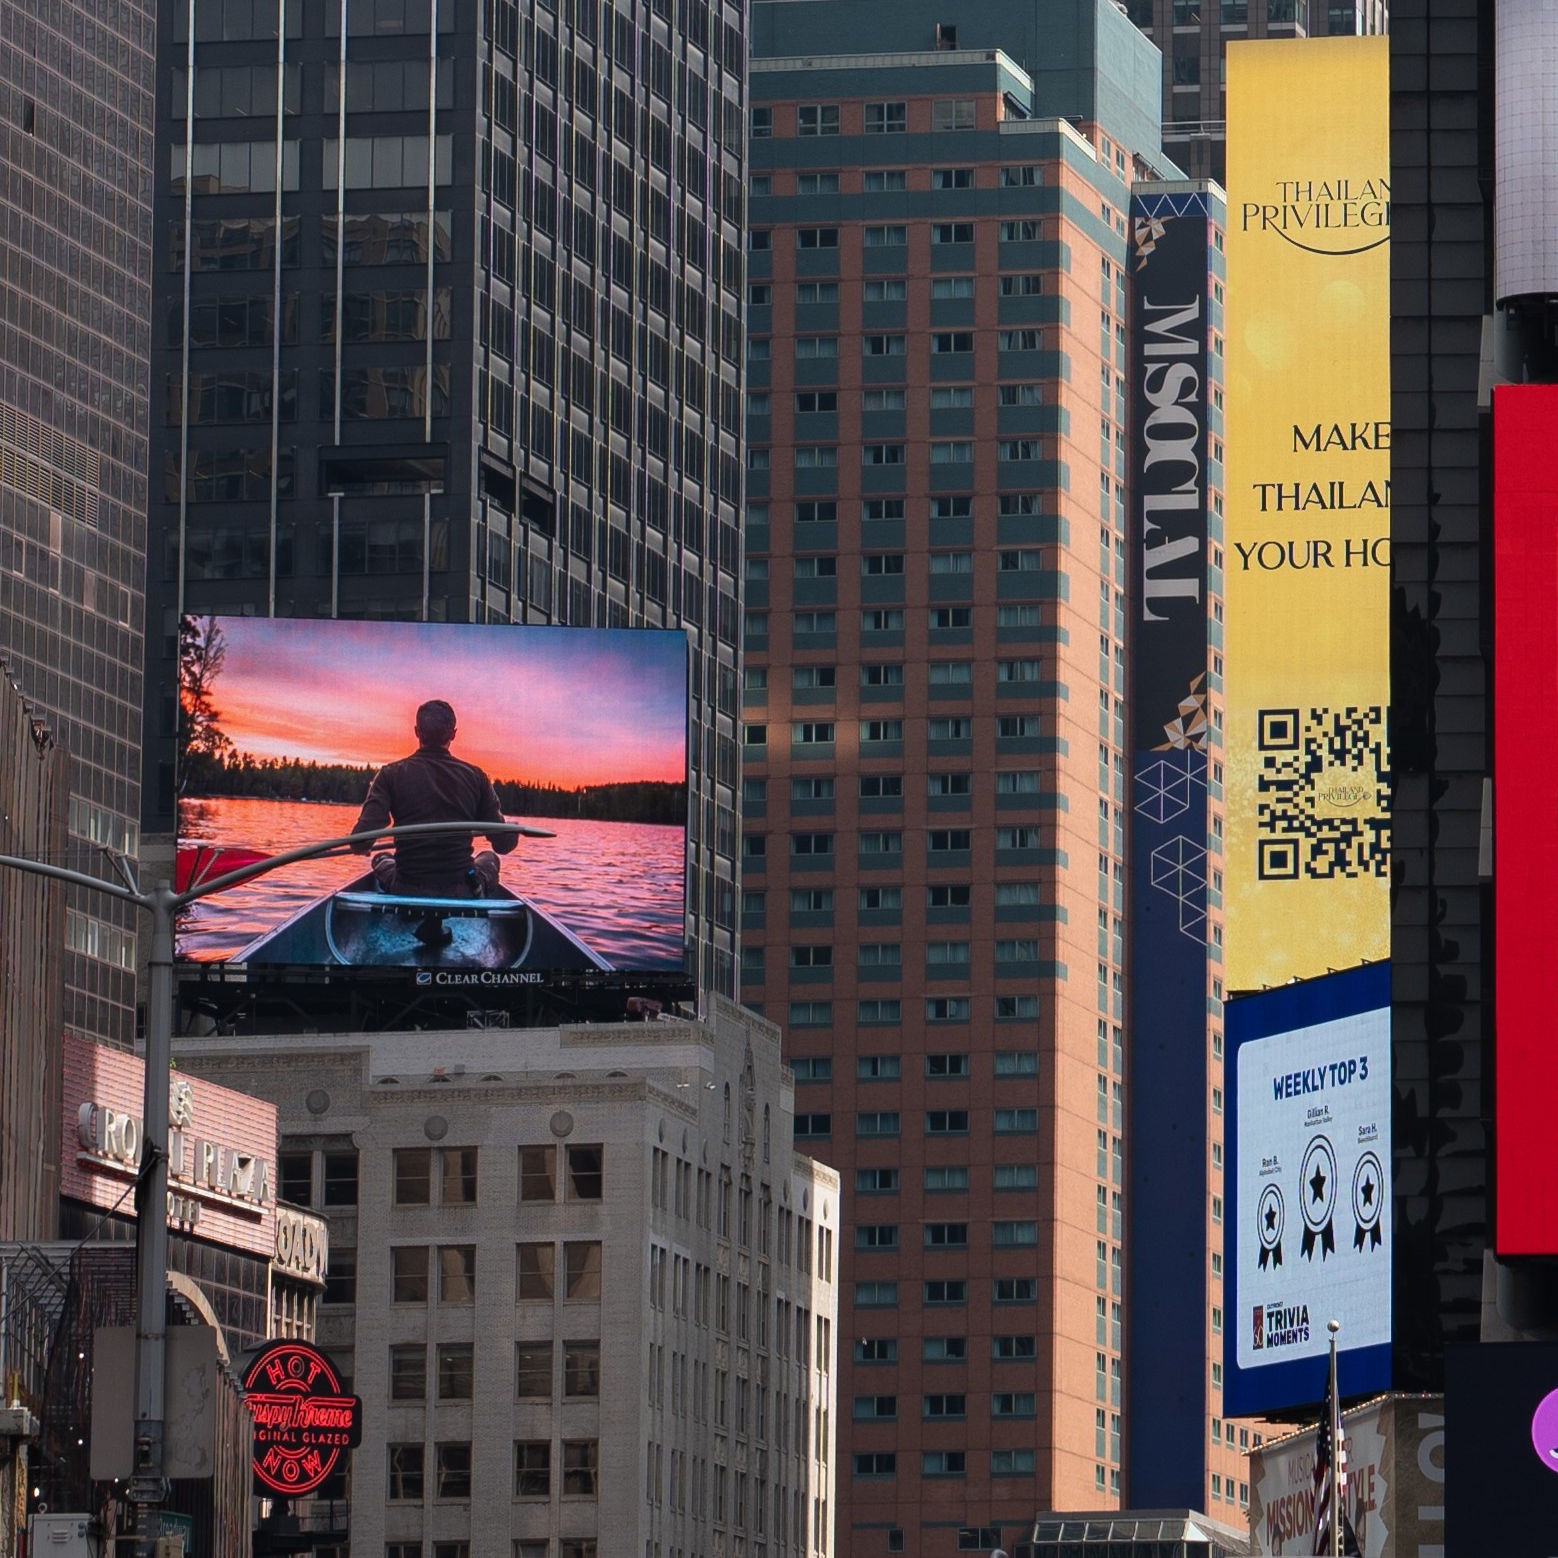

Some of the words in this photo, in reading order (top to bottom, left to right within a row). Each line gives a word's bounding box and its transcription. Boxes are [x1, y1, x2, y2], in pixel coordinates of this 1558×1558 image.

[1242, 201, 1390, 231] PRIVILEG
[1293, 421, 1390, 452] MAKE
[1233, 539, 1335, 571] YOUR
[435, 972, 479, 985] CLEAR
[480, 971, 545, 984] CHANNEL
[1273, 1065, 1327, 1101] WEEKLY
[1328, 1058, 1357, 1087] TOP
[1359, 1055, 1369, 1081] 3
[167, 1190, 201, 1225] OTEL
[1266, 1304, 1310, 1333] TRIVIA
[1266, 1327, 1310, 1349] MOMENTS
[266, 1355, 321, 1384] HOT
[253, 1430, 297, 1443] IGINAL
[302, 1431, 350, 1446] GLAZED
[262, 1447, 322, 1482] NOW
